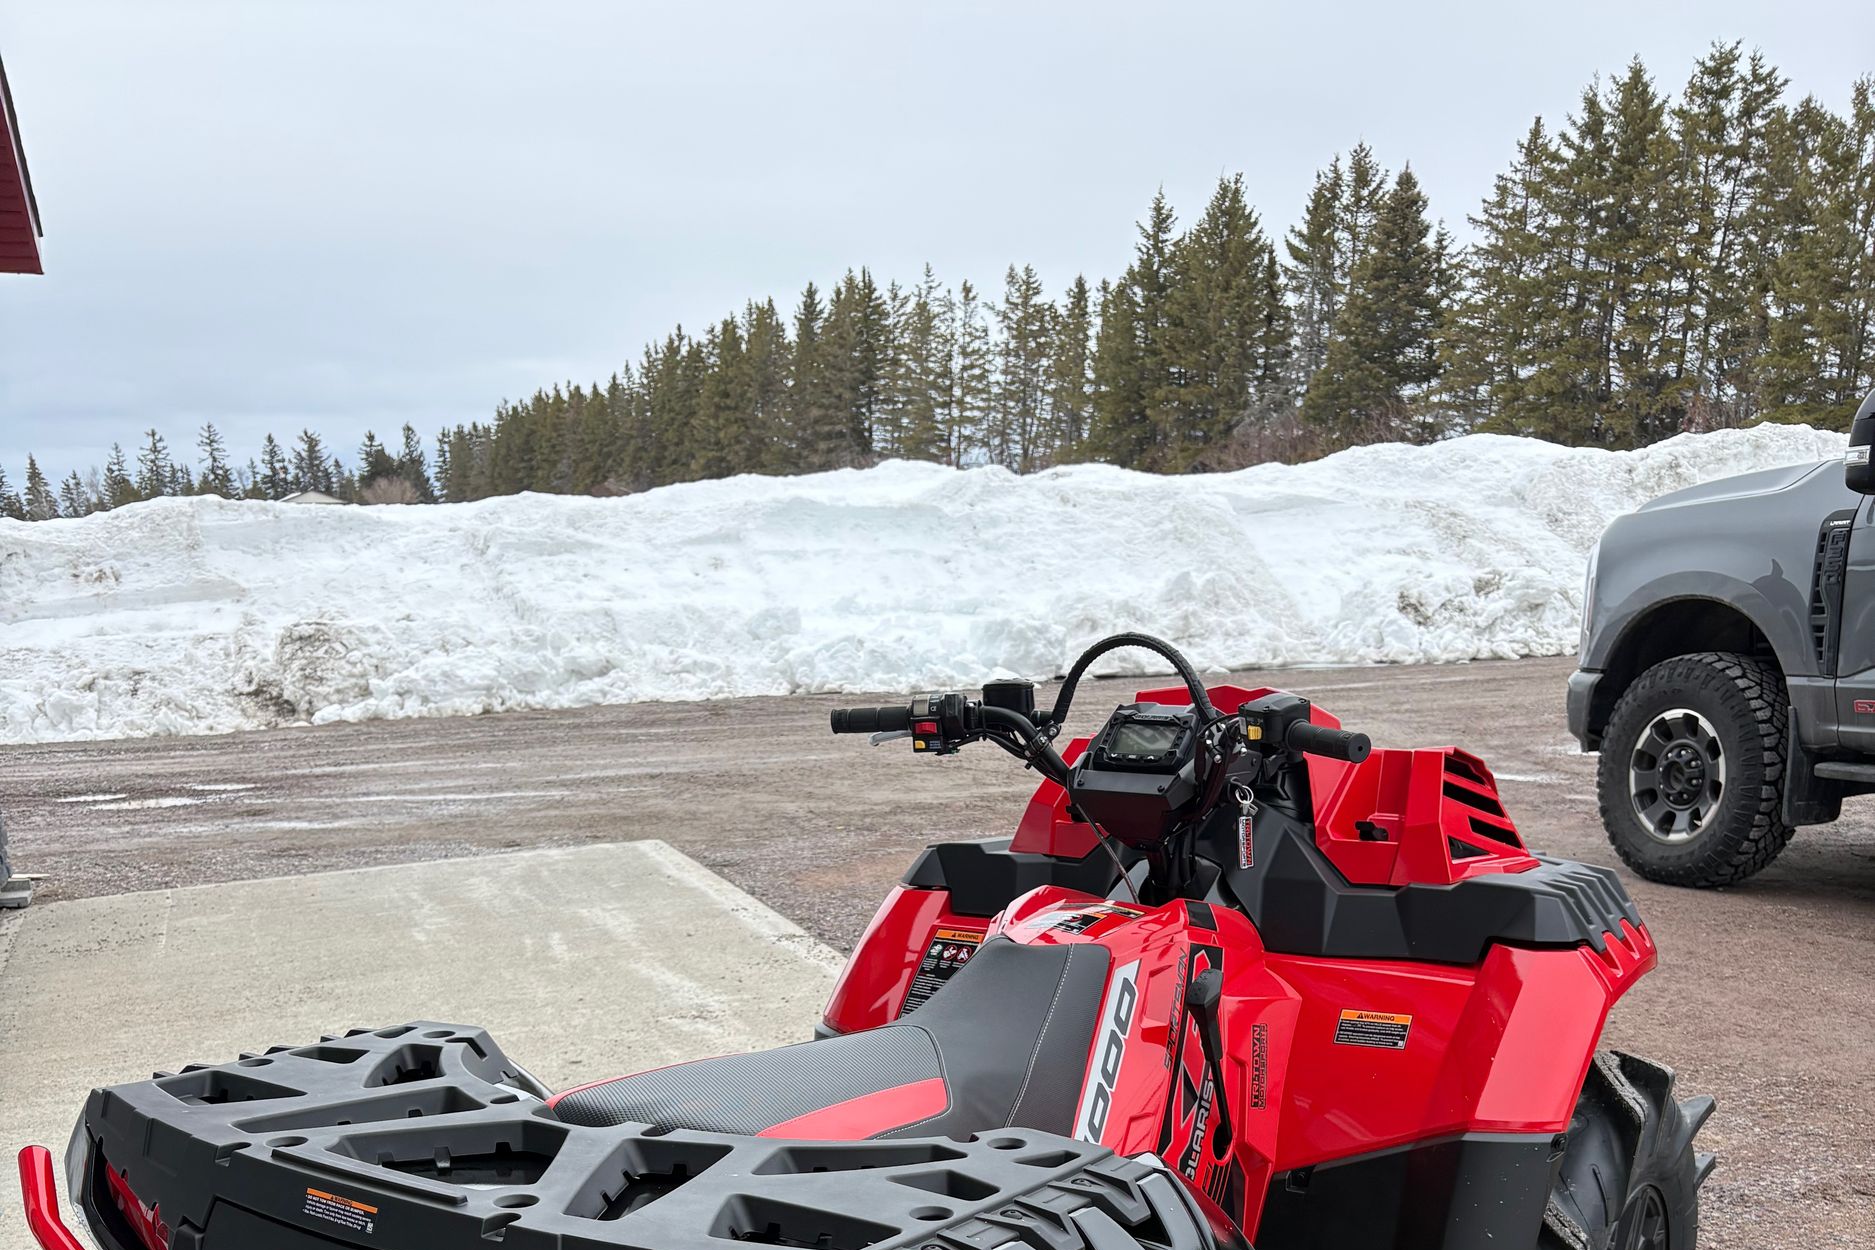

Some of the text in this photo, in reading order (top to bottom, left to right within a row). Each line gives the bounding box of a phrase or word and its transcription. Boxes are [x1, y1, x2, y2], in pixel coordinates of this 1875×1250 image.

[1084, 977, 1136, 1144] 000
[1163, 947, 1187, 1072] SPORTSMAN
[1363, 1013, 1395, 1021] WARNING
[1185, 1080, 1214, 1181] OLARIS
